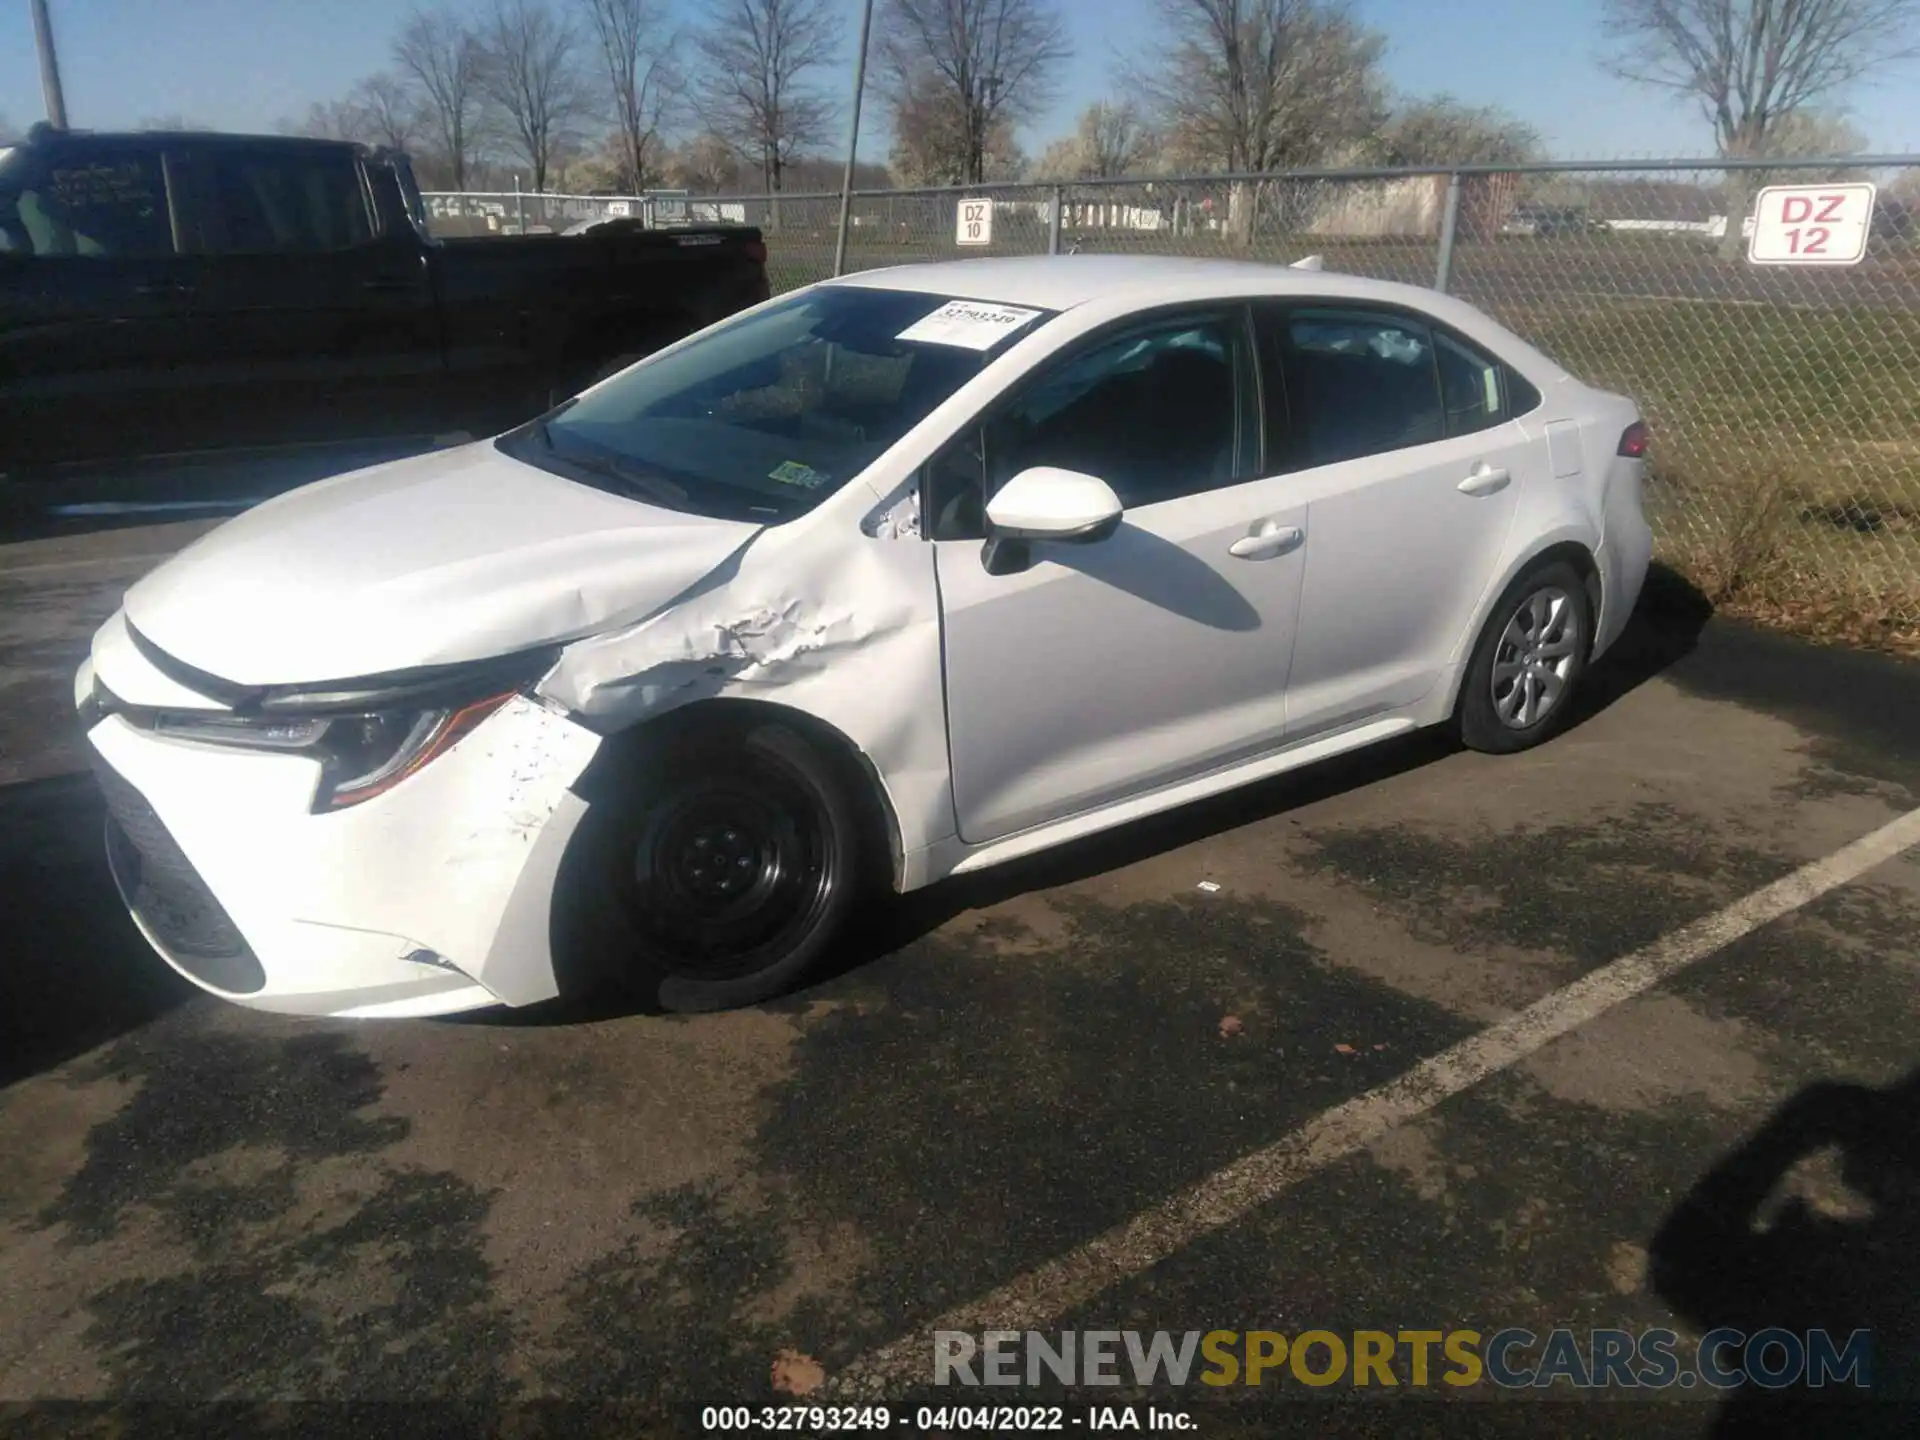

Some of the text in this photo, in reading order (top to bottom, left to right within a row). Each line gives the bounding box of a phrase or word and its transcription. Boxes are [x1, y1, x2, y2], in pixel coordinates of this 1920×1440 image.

[965, 204, 984, 222] DZ
[1781, 194, 1846, 224] DZ
[967, 222, 981, 238] 10
[1785, 227, 1830, 254] 12
